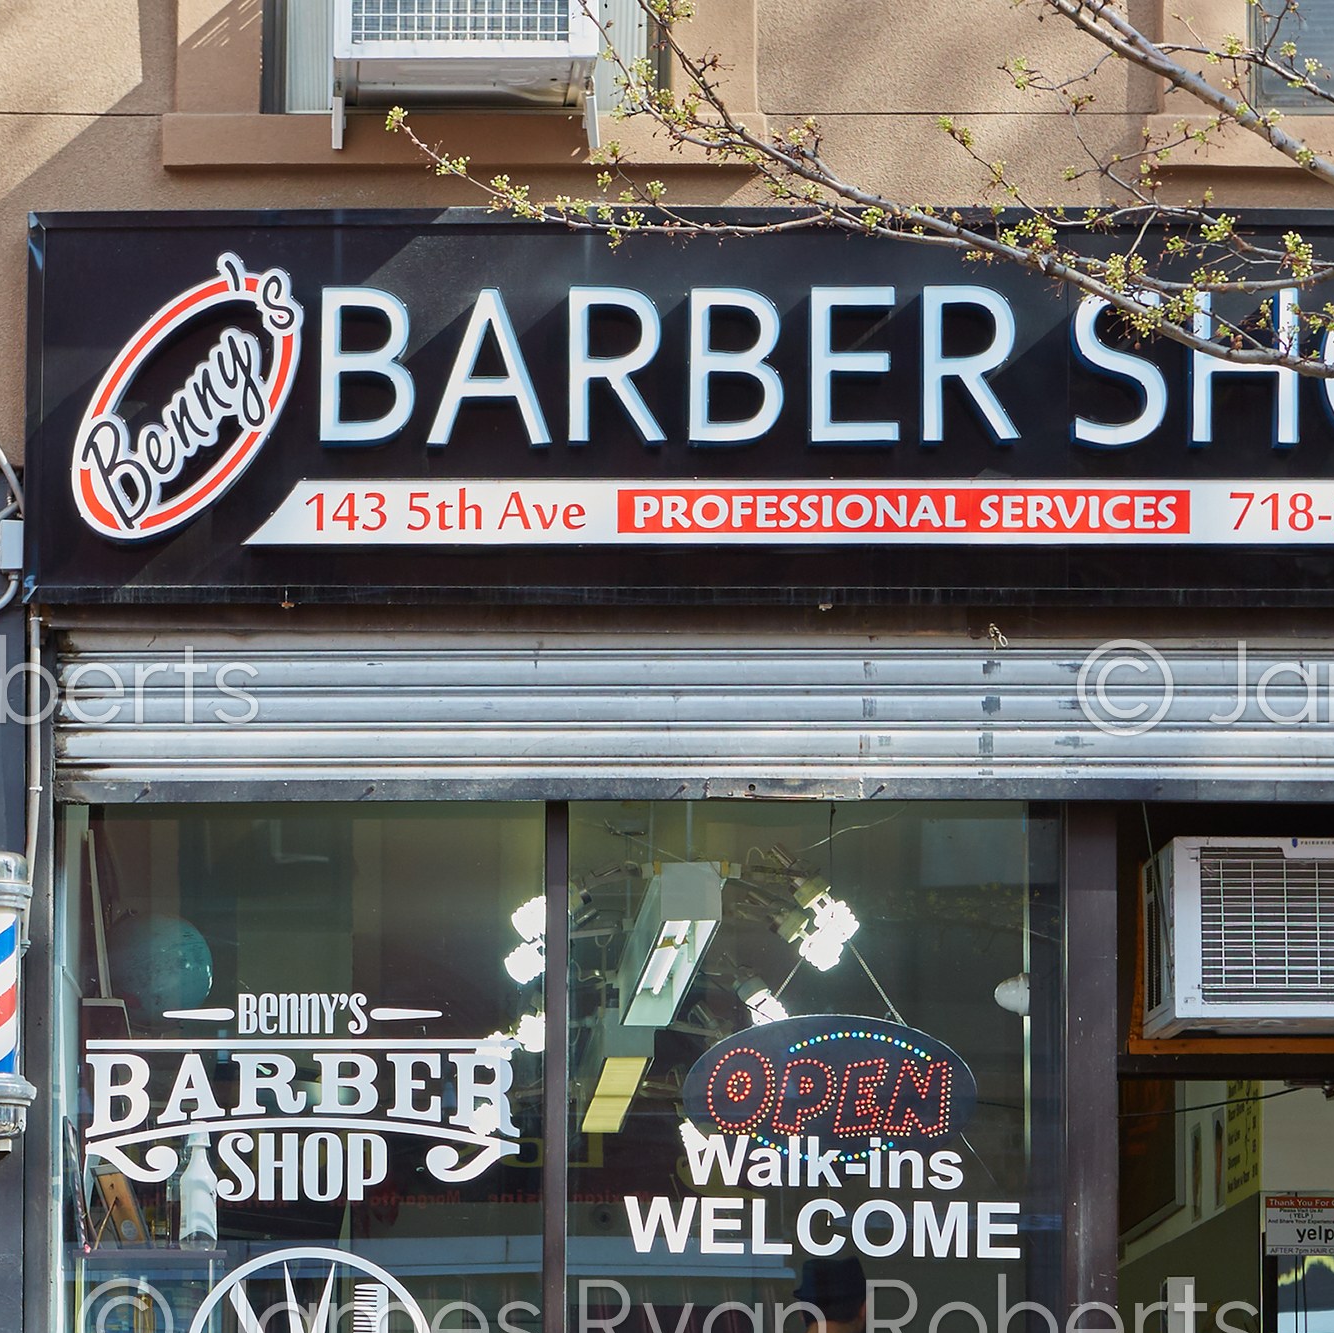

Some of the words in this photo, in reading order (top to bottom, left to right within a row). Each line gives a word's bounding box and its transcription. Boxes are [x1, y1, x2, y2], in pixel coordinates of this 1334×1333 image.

[80, 252, 297, 530] Benny's
[318, 285, 1021, 449] BARBER
[305, 491, 387, 532] 143
[405, 487, 484, 533] 5th
[497, 490, 588, 531] Ave
[631, 493, 967, 530] PROFESSIONAL
[978, 493, 1178, 531] SERVICES
[85, 1052, 521, 1139] BARBER
[706, 1046, 954, 1139] OPEN
[215, 1132, 388, 1202] SHOP
[684, 1134, 964, 1190] Walk-ins
[623, 1196, 1022, 1261] WELCOME
[1269, 1199, 1295, 1207] Thank
[1296, 1199, 1313, 1207] You
[1314, 1199, 1329, 1207] For
[1296, 1225, 1334, 1244] yelp
[1295, 1247, 1309, 1255] 7pm
